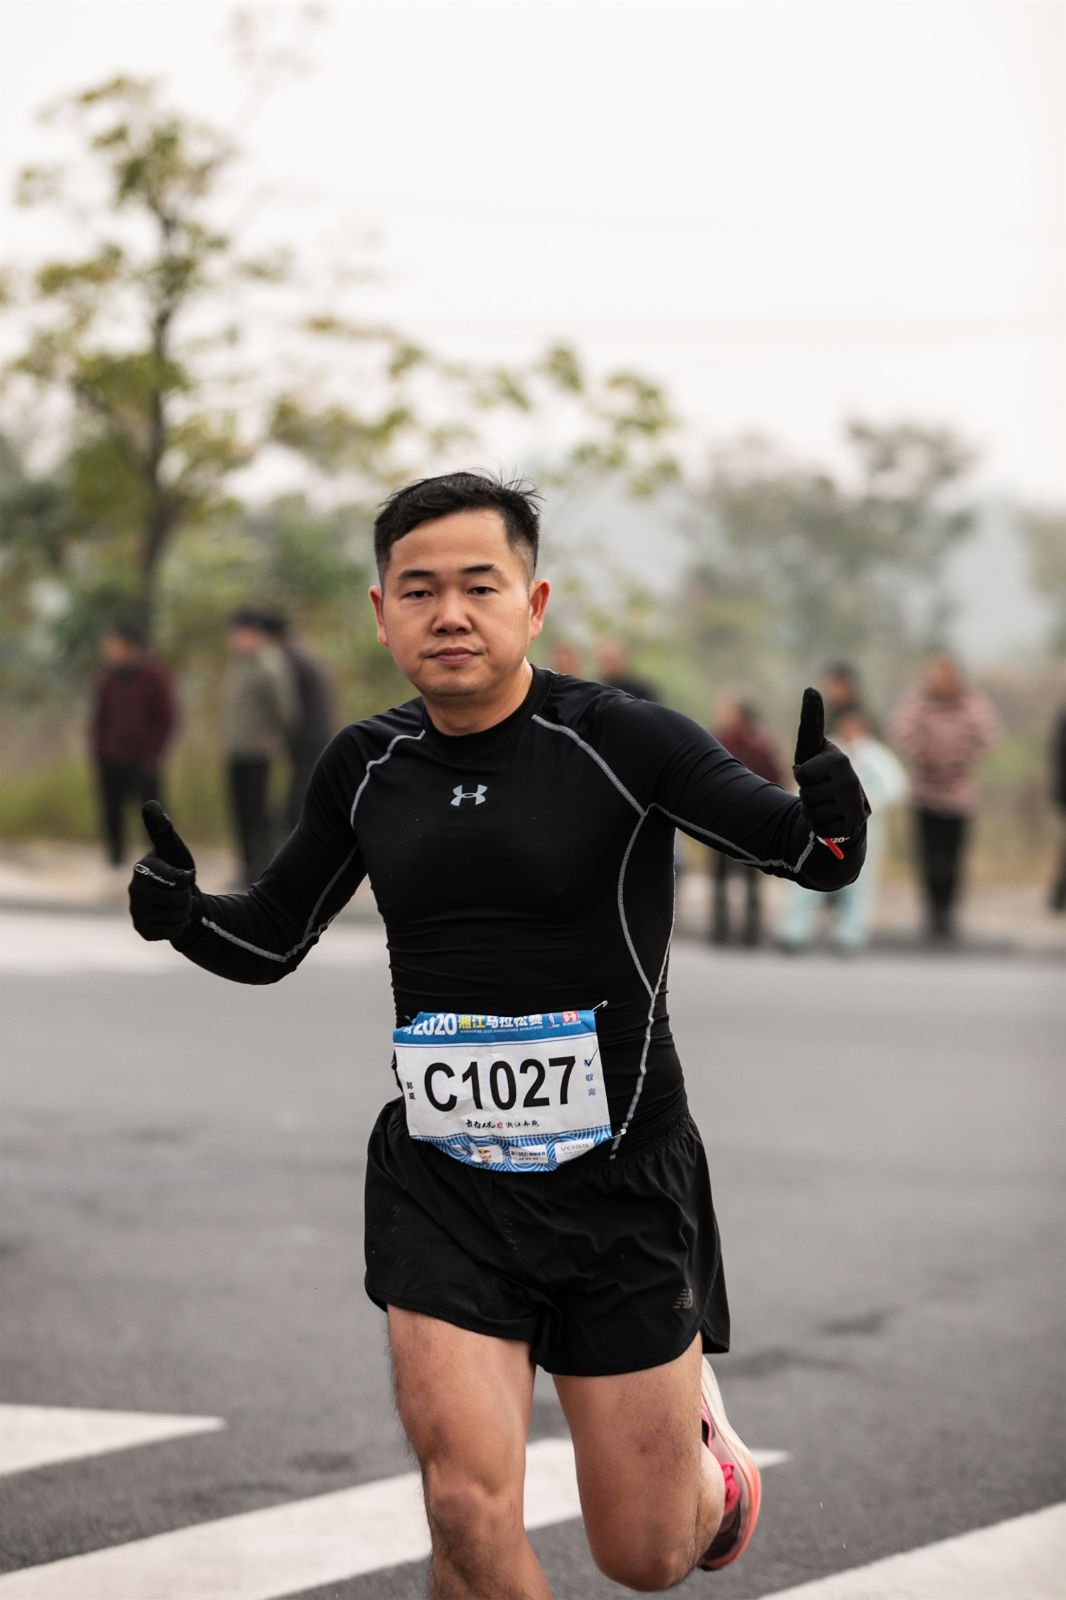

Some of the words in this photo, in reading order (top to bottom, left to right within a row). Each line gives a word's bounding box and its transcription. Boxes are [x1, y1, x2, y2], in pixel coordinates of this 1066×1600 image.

[413, 1013, 458, 1036] 2020
[458, 1013, 543, 1029] 湘江马拉松赛
[424, 1055, 577, 1113] C1027
